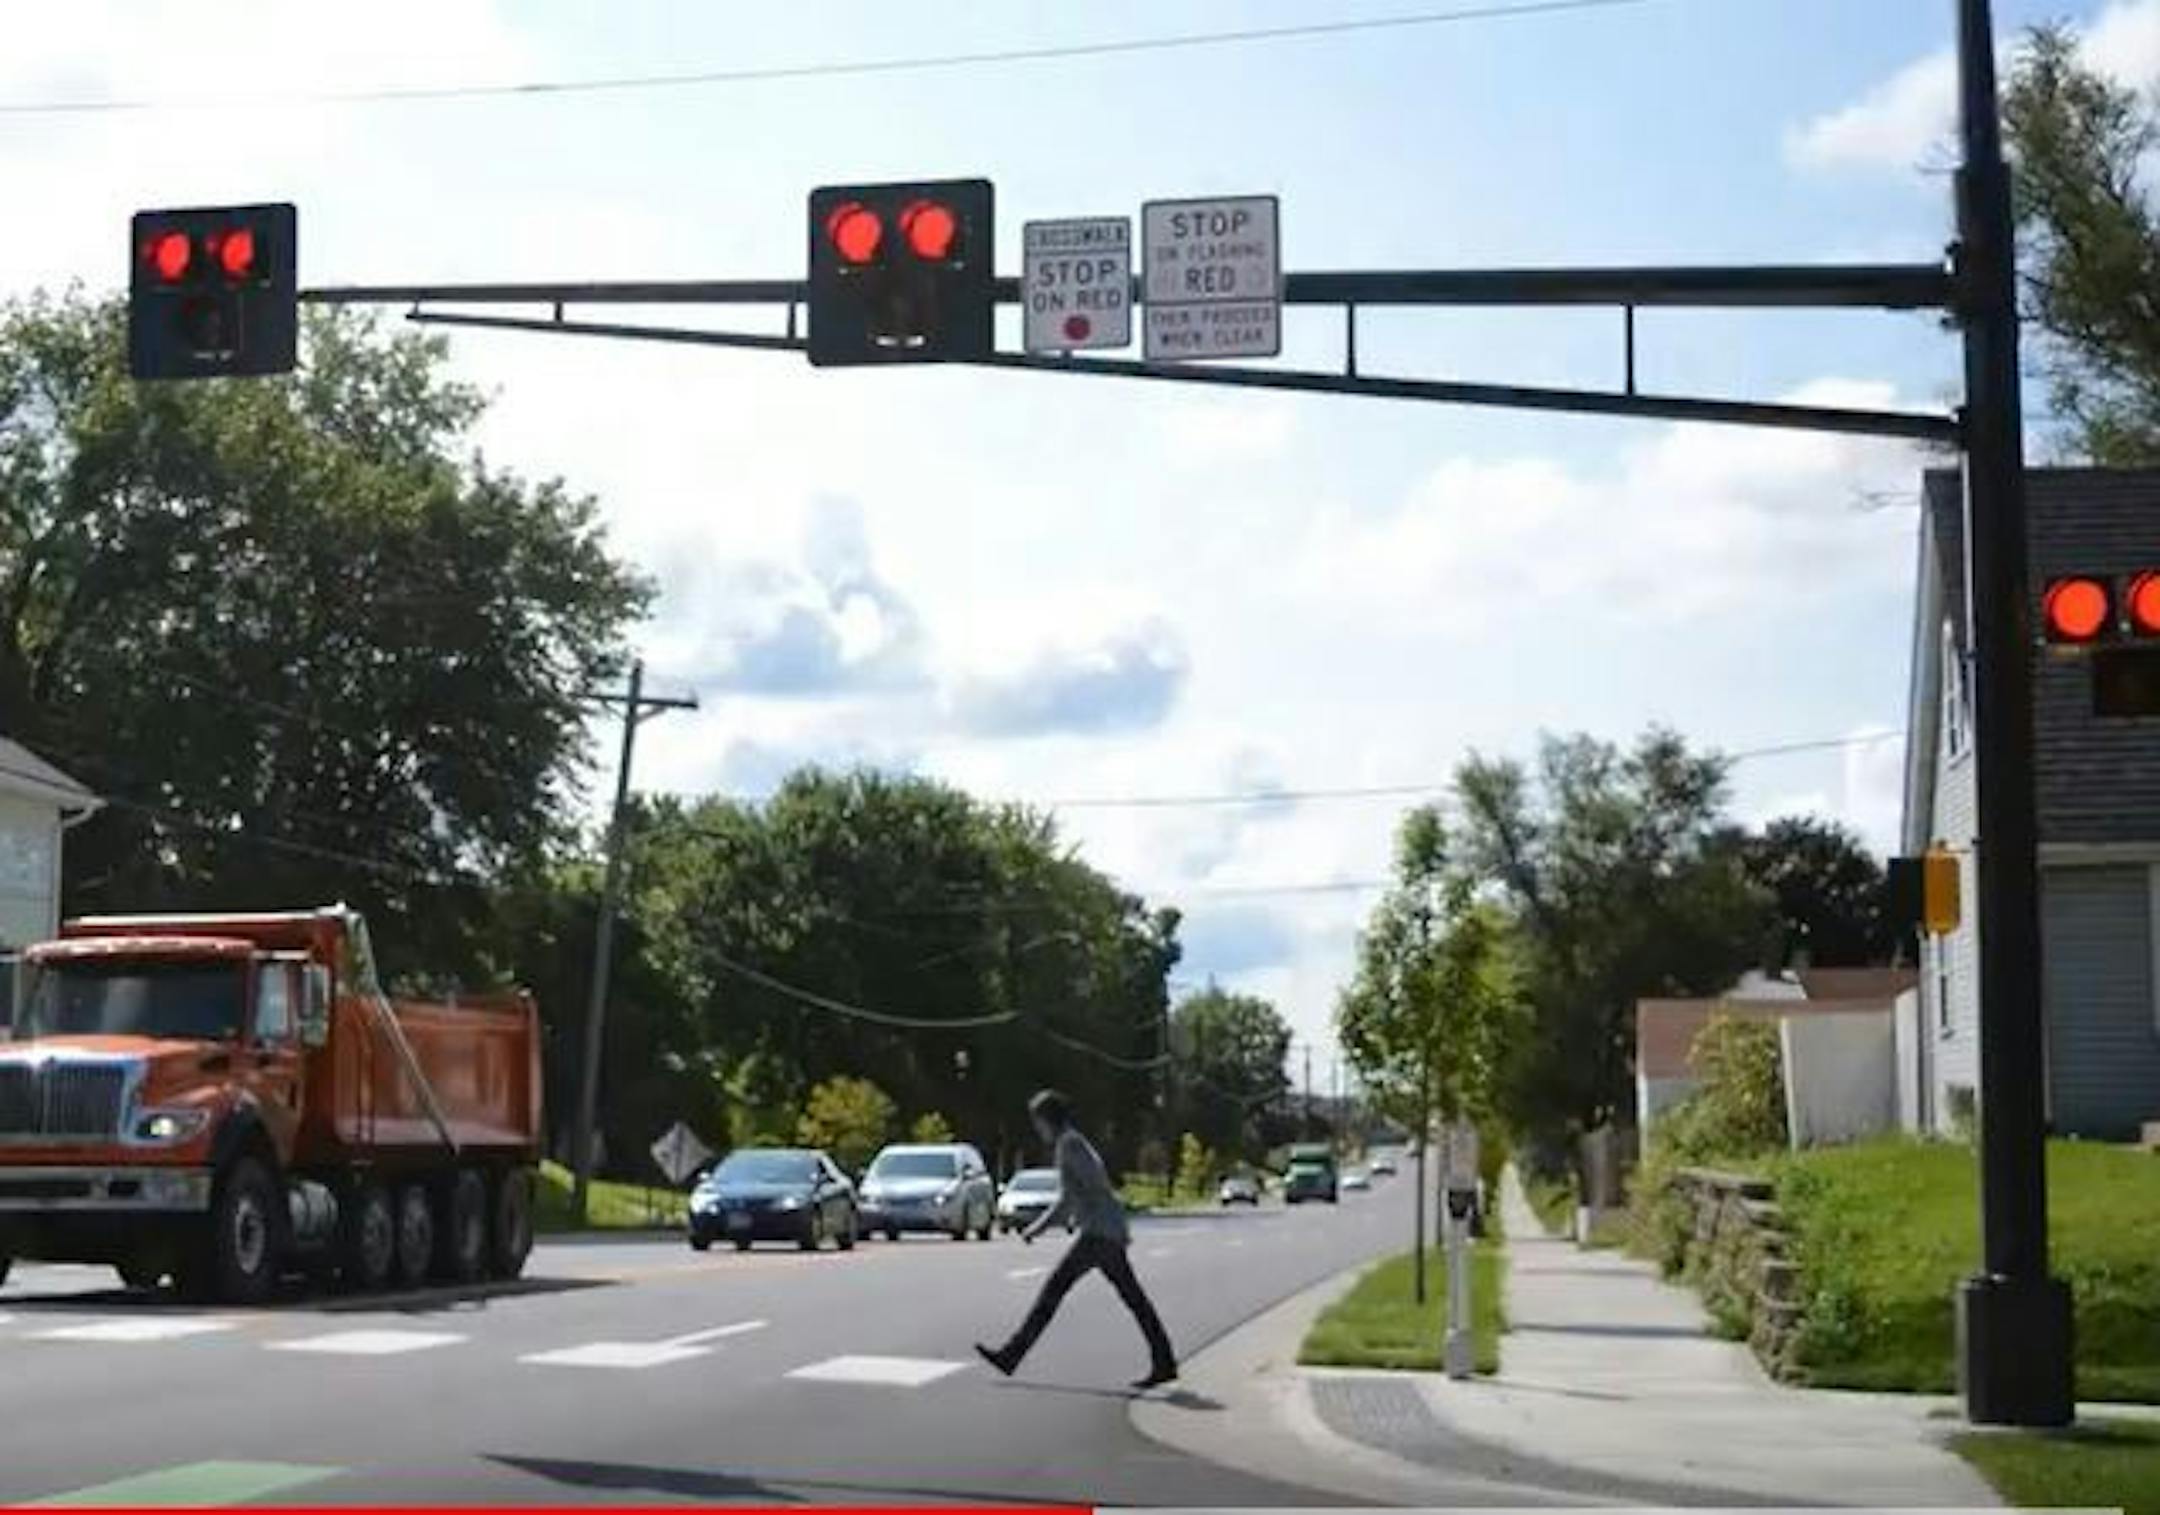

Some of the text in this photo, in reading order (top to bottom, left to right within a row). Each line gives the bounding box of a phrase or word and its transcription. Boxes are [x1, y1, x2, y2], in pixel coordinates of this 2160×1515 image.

[1170, 210, 1248, 239] STOP
[1038, 260, 1117, 287] STOP
[1184, 265, 1236, 293] RED
[1033, 288, 1121, 313] ON RED
